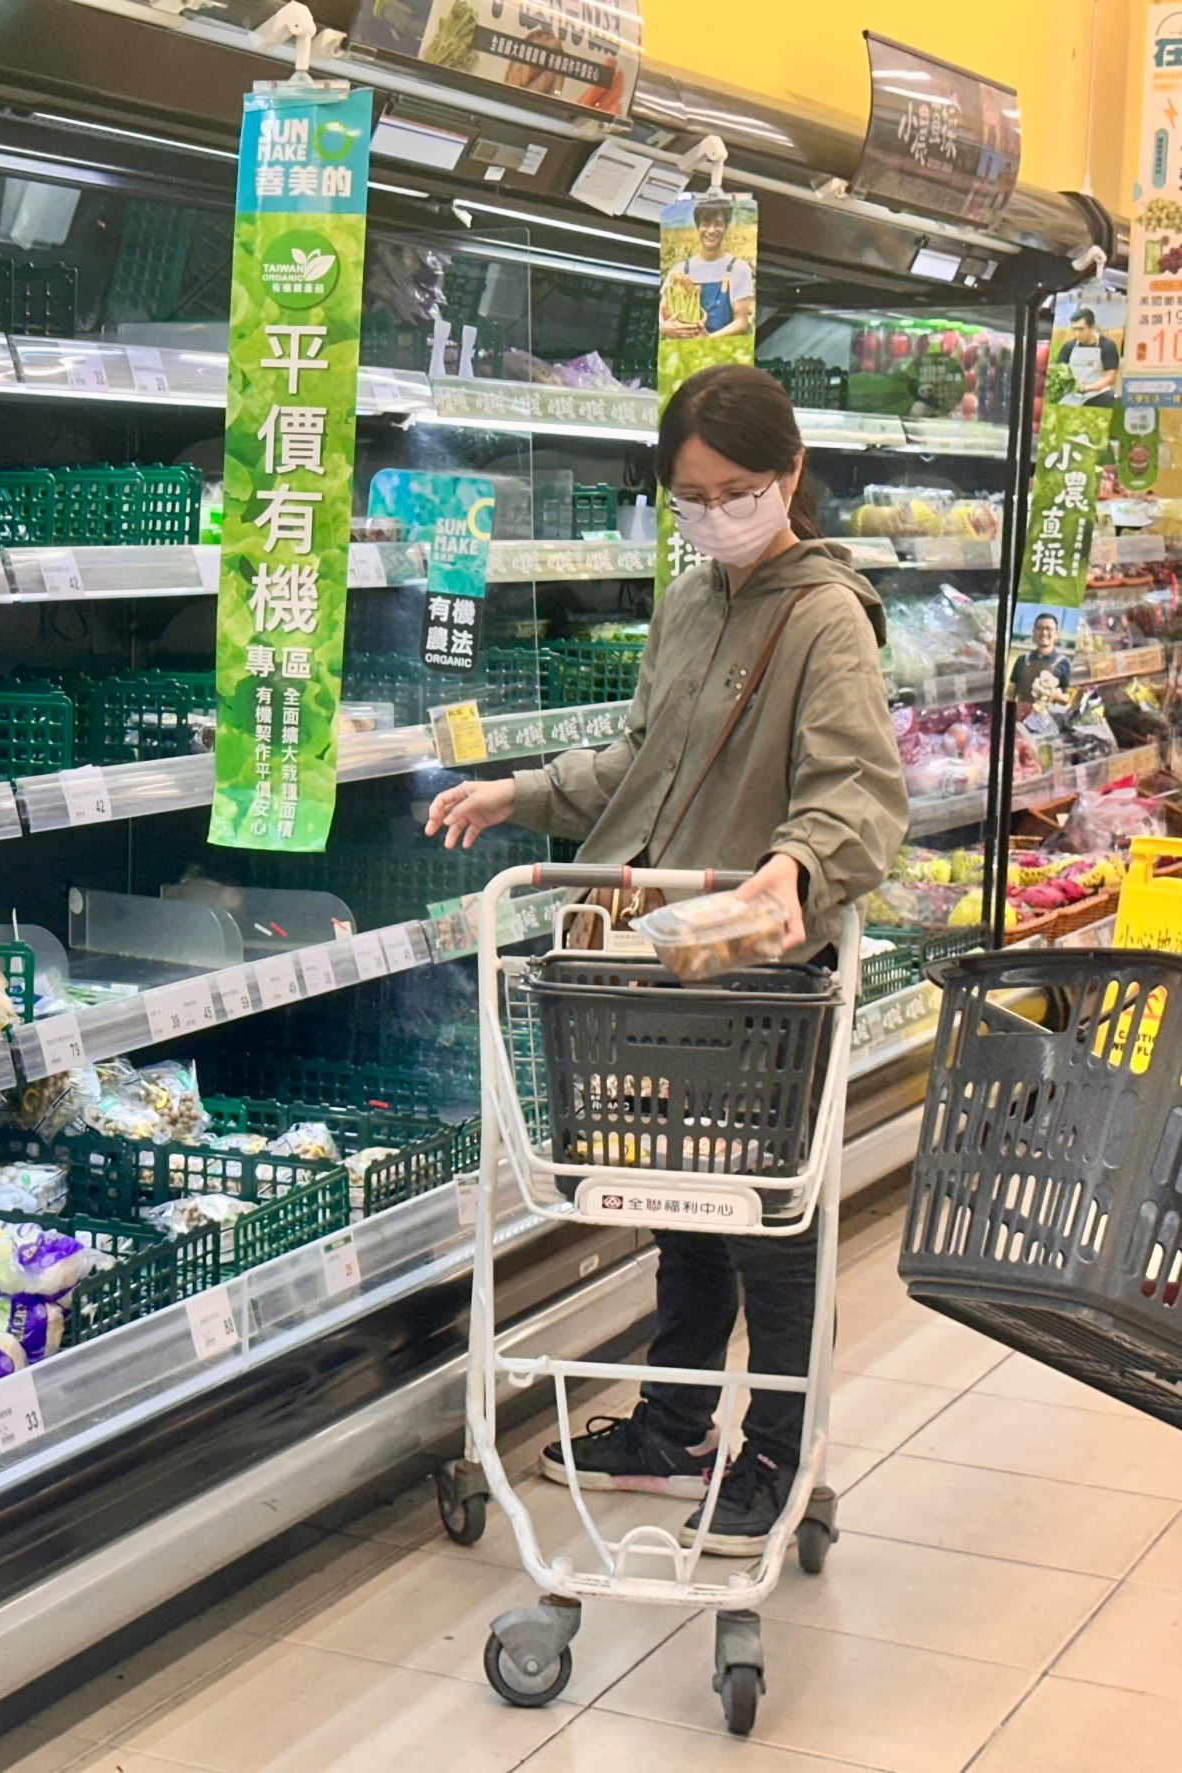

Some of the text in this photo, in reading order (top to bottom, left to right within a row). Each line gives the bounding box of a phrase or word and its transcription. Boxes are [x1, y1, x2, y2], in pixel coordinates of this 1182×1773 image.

[260, 118, 309, 143] SUN
[257, 143, 307, 162] MAKE
[255, 165, 352, 197] 善美的
[262, 273, 305, 283] ORGANIC
[263, 263, 305, 274] TAIWAN
[249, 325, 329, 635] 平價有機
[1031, 442, 1090, 578] 小農直採
[435, 517, 468, 537] SUN
[433, 535, 480, 556] MAKE
[429, 596, 476, 626] 有機
[425, 626, 474, 656] 農法
[244, 644, 312, 679] 專區
[424, 652, 473, 668] ORGANIC
[250, 686, 273, 836] 有機契作平價安心
[277, 687, 301, 838] 全面擴大栽種面積
[95, 800, 106, 813] 42
[1119, 924, 1182, 949] 小心地
[70, 1042, 80, 1057] 79
[628, 1197, 734, 1217] 全聯福利中心
[25, 1410, 39, 1432] 33
